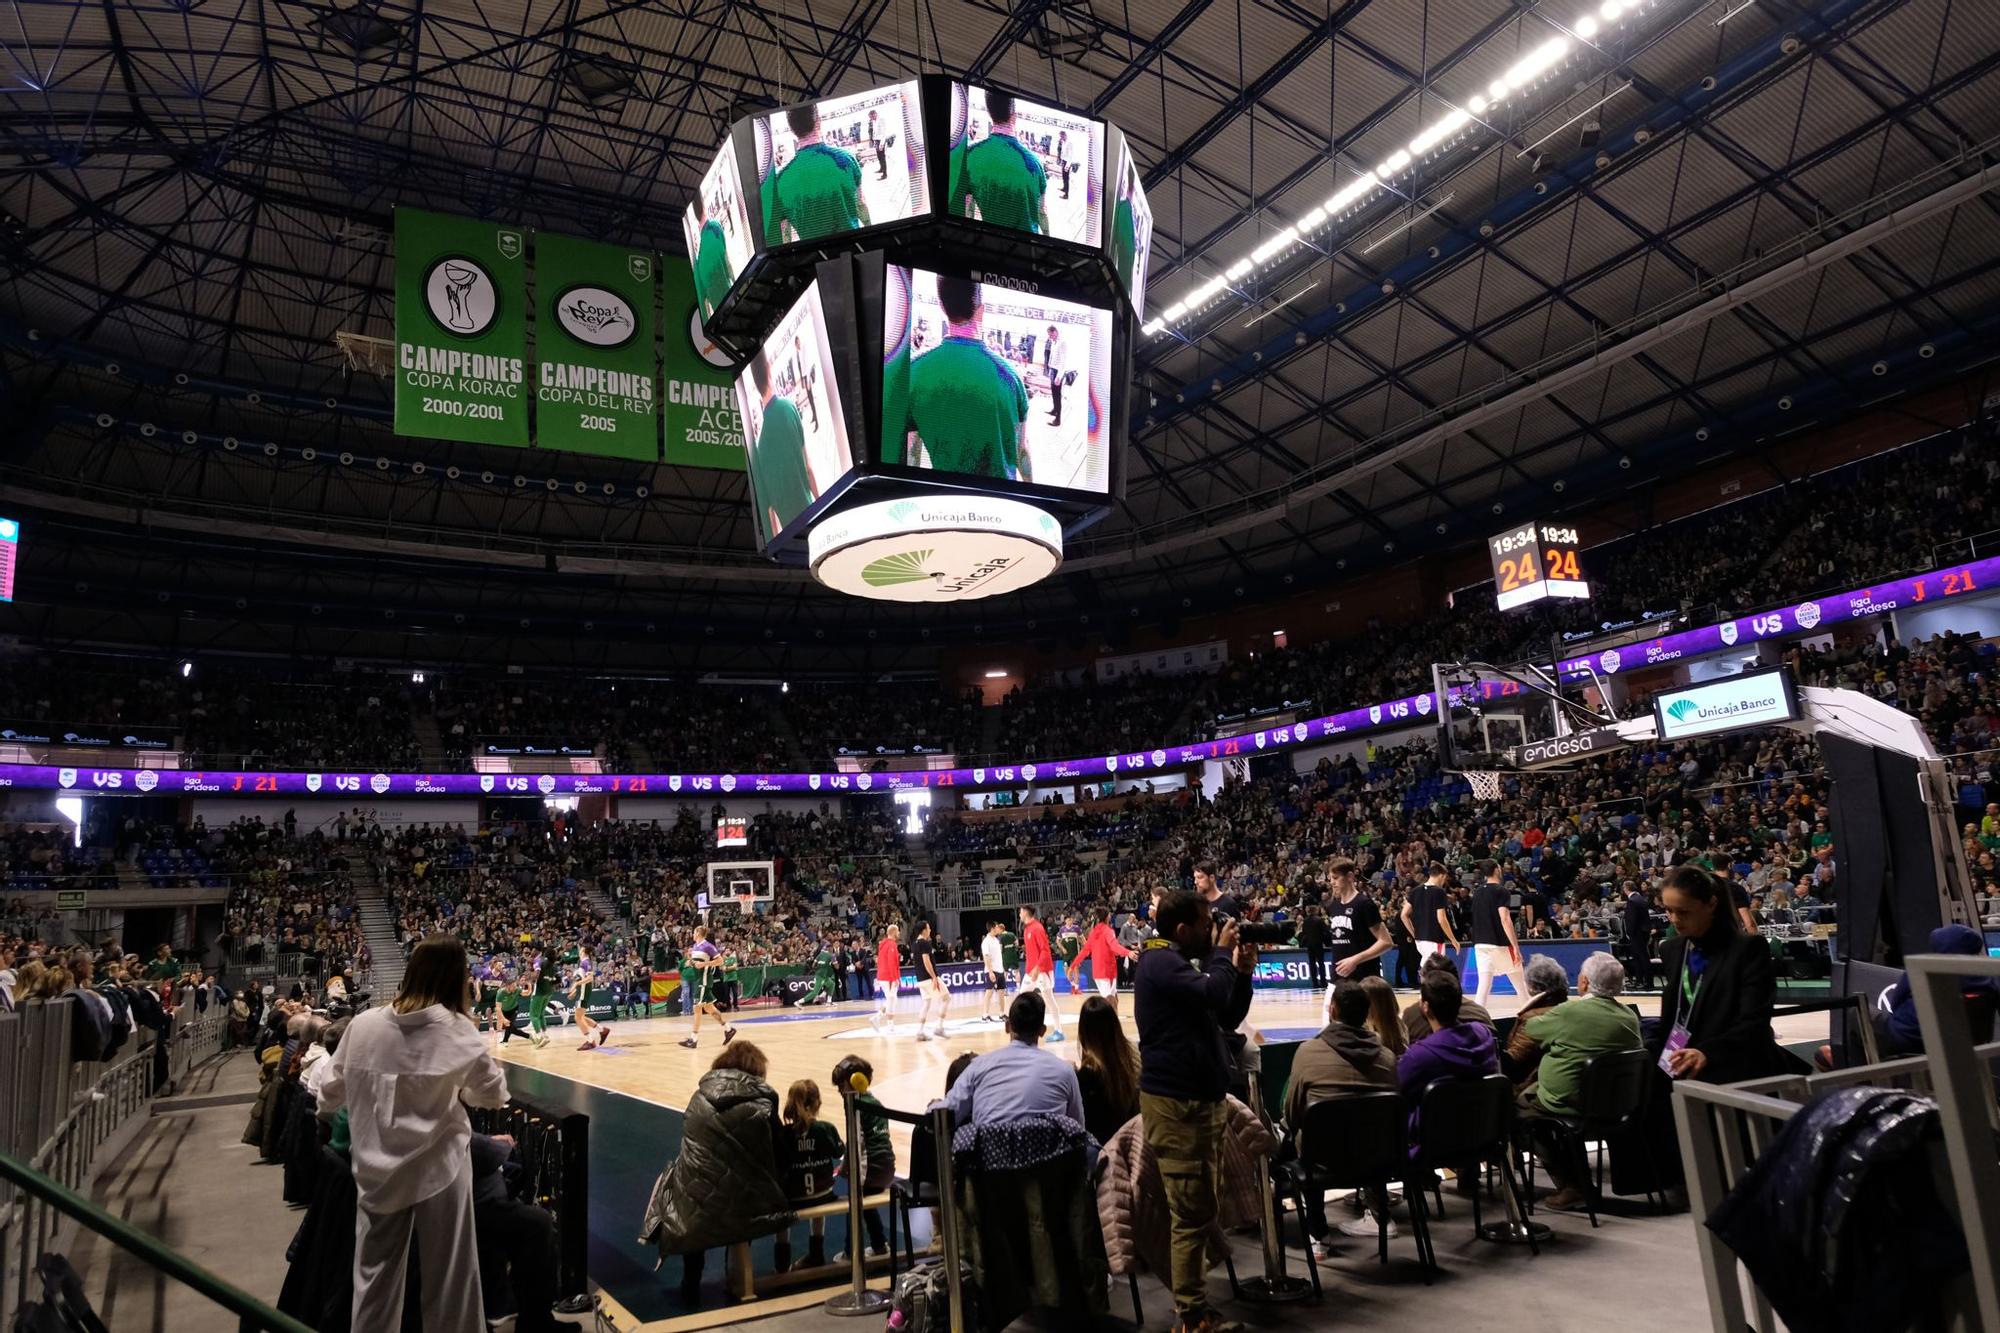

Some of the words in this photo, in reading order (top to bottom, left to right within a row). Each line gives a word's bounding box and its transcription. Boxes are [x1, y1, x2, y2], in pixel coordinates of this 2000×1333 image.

[984, 272, 1039, 294] MONDO
[568, 305, 605, 325] Rey
[577, 300, 611, 316] Copa
[400, 343, 523, 384] CAMPEONES
[406, 371, 455, 391] COPA
[459, 378, 518, 399] KORAC
[541, 362, 652, 400] CAMPEONES
[539, 387, 584, 405] COPA
[588, 393, 619, 410] DEL
[623, 397, 654, 415] REY
[669, 379, 739, 411] CAMPEO
[423, 397, 504, 421] 2000/2001
[580, 414, 617, 433] 2005
[686, 428, 746, 447] 2005/20
[921, 512, 966, 523] Unicaja
[968, 512, 1002, 523] Banco
[1493, 527, 1537, 555] 19:34
[1541, 526, 1579, 544] 19:34
[1500, 552, 1537, 592] 24
[1546, 550, 1581, 580] 24
[936, 558, 1010, 592] Unicaja
[1912, 581, 1926, 602] J
[1941, 570, 1977, 595] 21
[1850, 596, 1871, 610] liga
[1852, 600, 1897, 617] endesa
[1752, 614, 1783, 635] VS
[1646, 646, 1662, 659] liga
[1647, 650, 1682, 664] endesa
[1567, 659, 1591, 679] VS
[1502, 681, 1520, 696] 21
[1390, 702, 1409, 718] VS
[1698, 702, 1740, 719] Unicaja
[1741, 696, 1776, 711] Banco
[1323, 721, 1334, 730] liga
[1273, 730, 1289, 744] VS
[1225, 742, 1240, 756] 21
[1524, 735, 1594, 762] endesa
[1126, 755, 1145, 768] VS
[93, 772, 122, 788] VS
[184, 777, 200, 786] liga
[922, 774, 929, 787] J
[938, 774, 954, 785] 21
[995, 768, 1014, 781] VS
[184, 783, 220, 792] endesa
[232, 776, 243, 791] J
[255, 776, 278, 791] 21
[336, 777, 361, 790] VS
[415, 779, 430, 787] liga
[415, 784, 446, 793] endesa
[506, 777, 528, 791] VS
[574, 780, 588, 788] liga
[574, 785, 603, 793] endesa
[611, 779, 620, 791] J
[630, 778, 647, 791] 21
[692, 777, 713, 790] VS
[830, 777, 849, 788] VS
[728, 826, 744, 838] 24
[589, 1004, 612, 1012] Banco
[804, 1173, 814, 1195] 9
